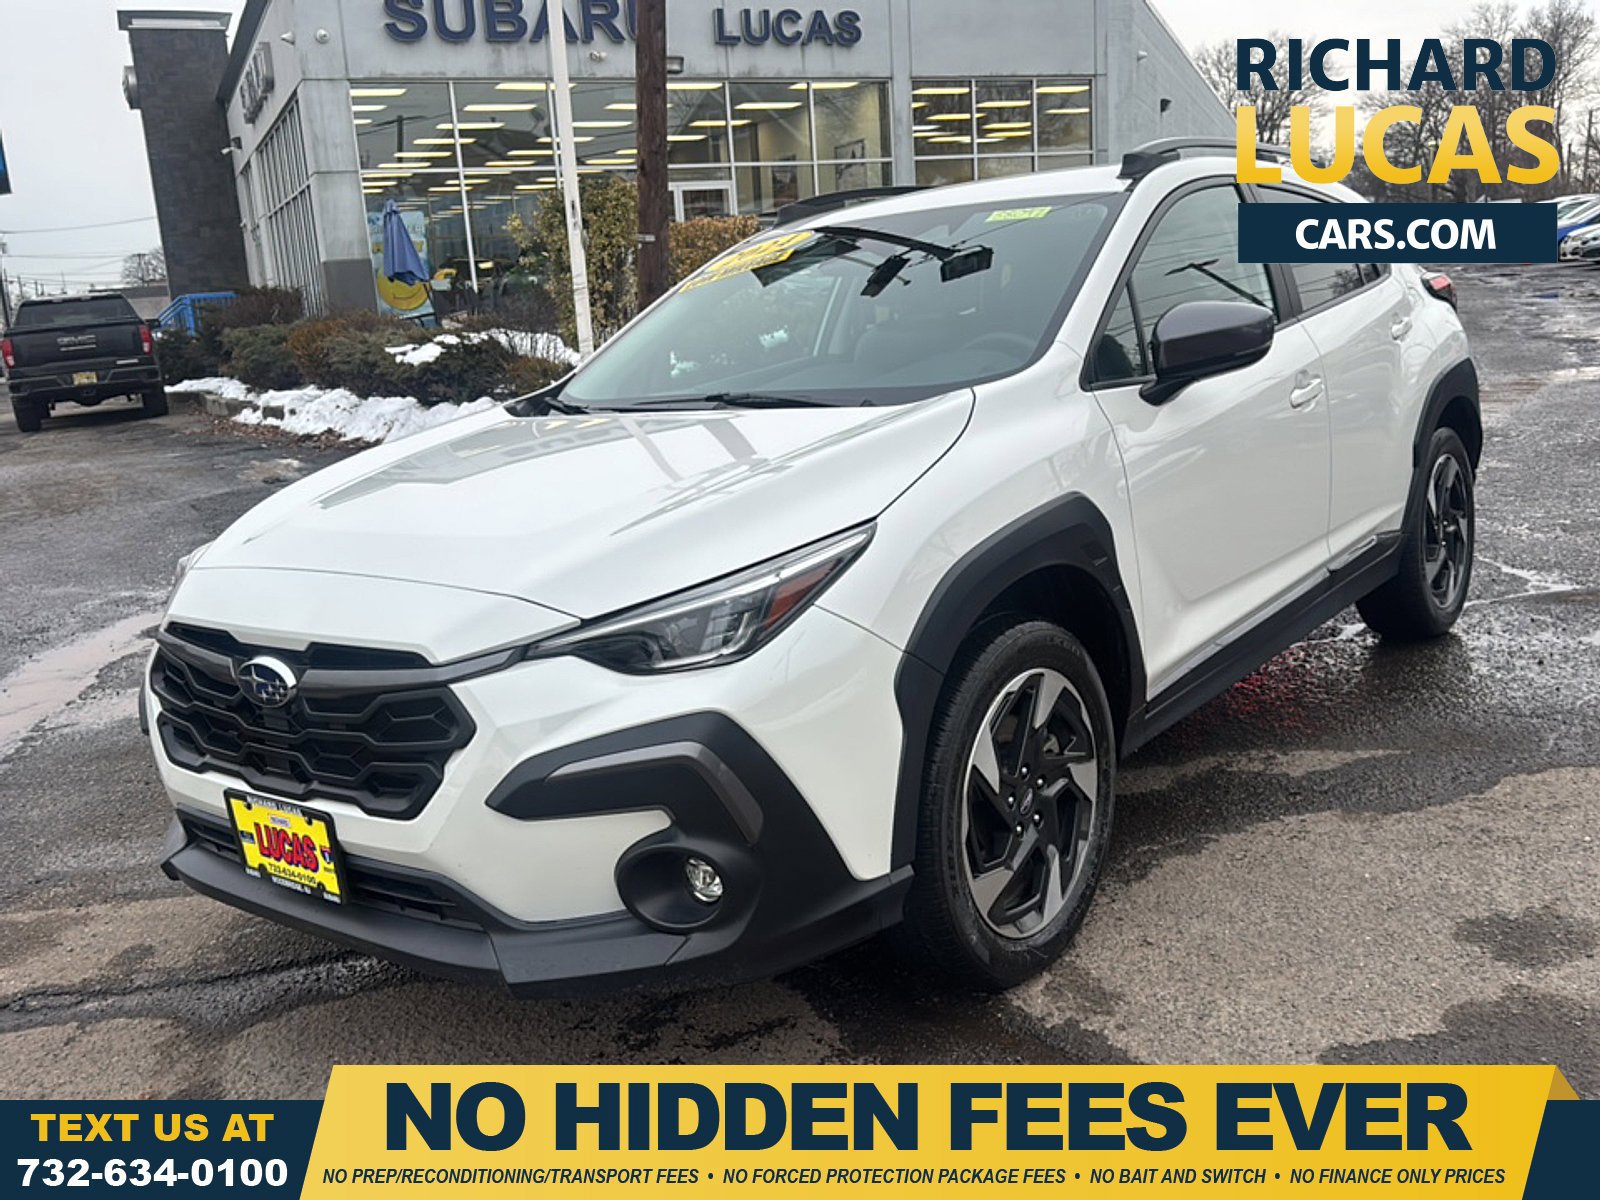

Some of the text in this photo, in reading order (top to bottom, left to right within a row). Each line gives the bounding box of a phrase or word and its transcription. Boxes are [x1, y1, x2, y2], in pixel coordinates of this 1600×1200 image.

[384, 0, 638, 44] SUBAR
[714, 8, 861, 46] LUCAS
[254, 822, 319, 872] LUCAS
